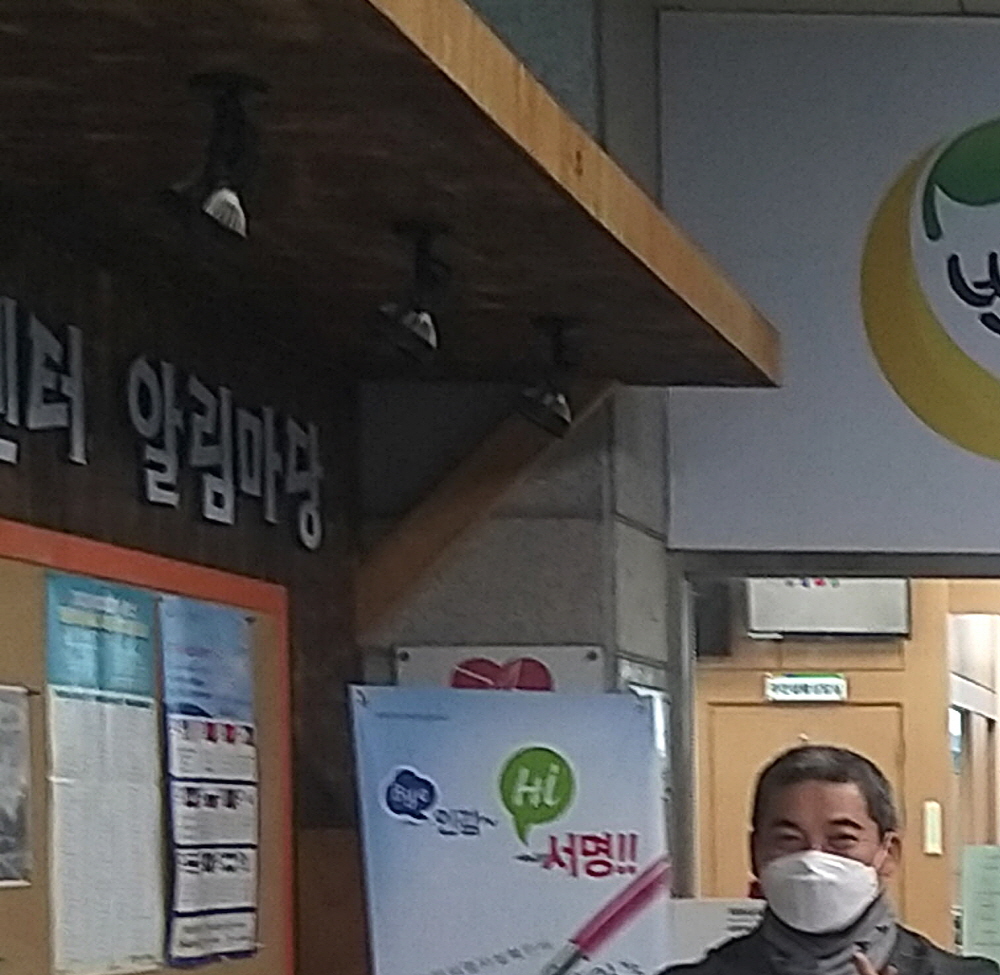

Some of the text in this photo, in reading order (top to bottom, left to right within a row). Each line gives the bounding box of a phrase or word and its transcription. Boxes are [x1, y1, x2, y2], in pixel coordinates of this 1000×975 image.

[0, 297, 324, 551] 터 알림마당
[511, 764, 563, 808] Hi
